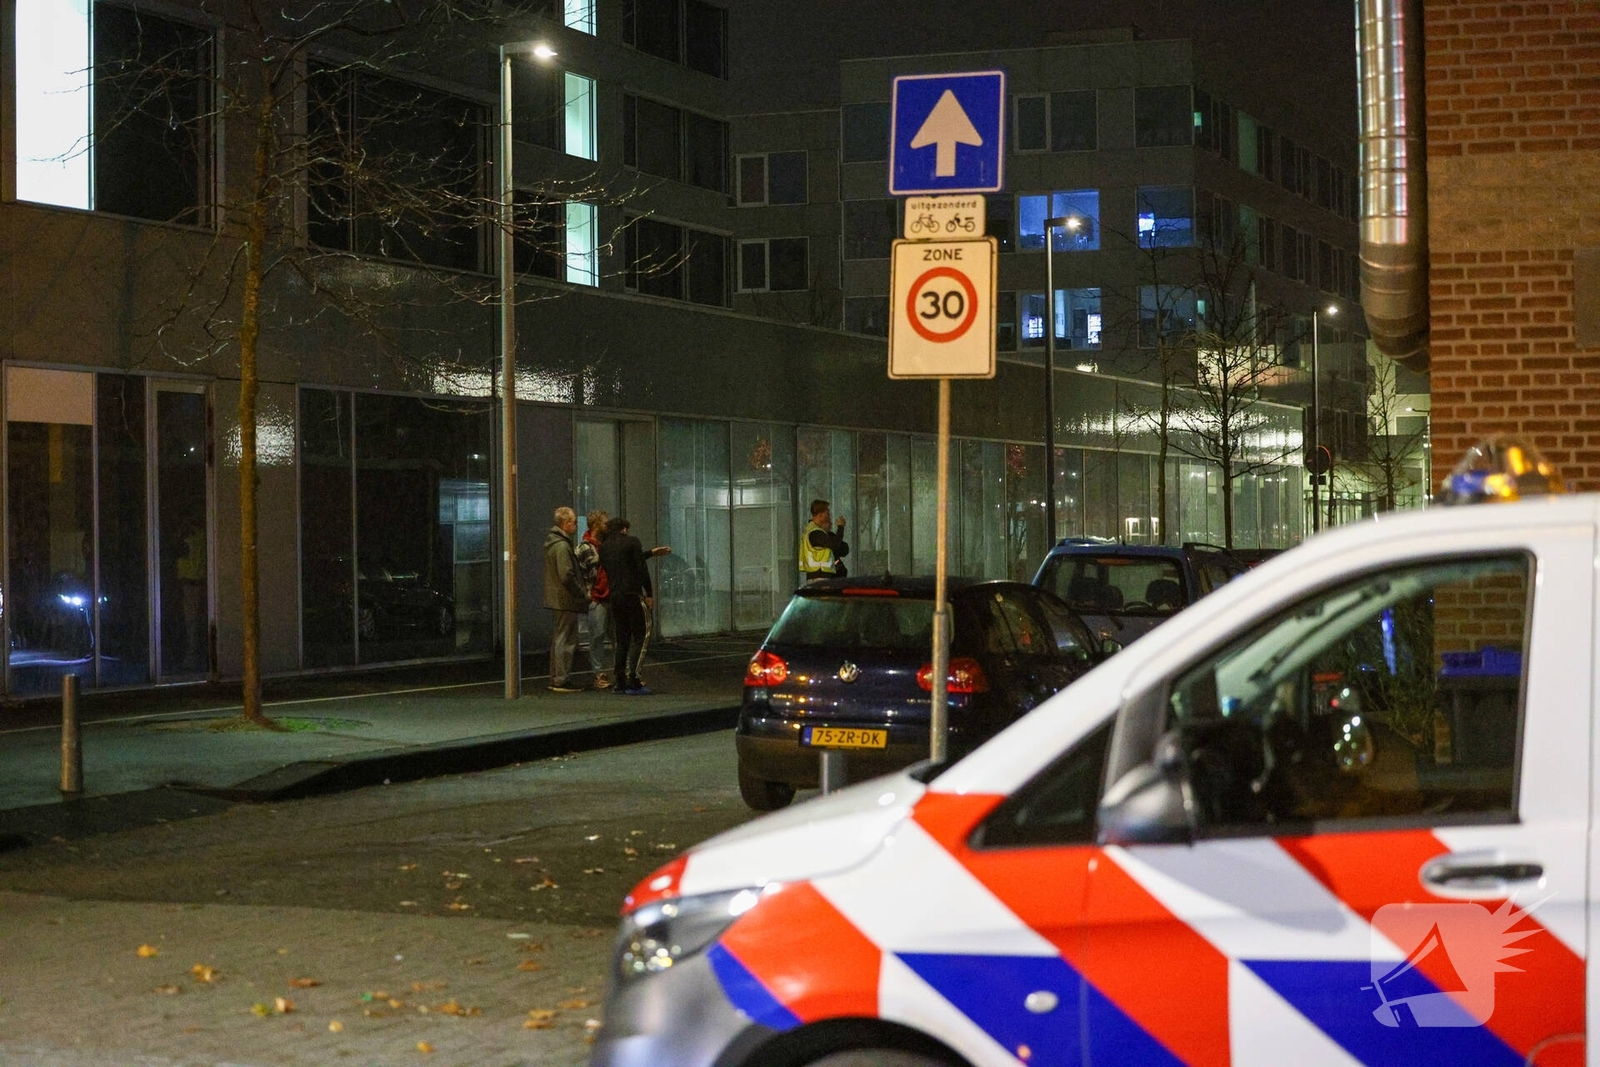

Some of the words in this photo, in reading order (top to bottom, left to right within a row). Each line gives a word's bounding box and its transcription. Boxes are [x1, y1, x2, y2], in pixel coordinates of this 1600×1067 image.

[911, 200, 977, 211] uitgezonderd
[923, 249, 963, 262] ZONE
[920, 291, 965, 320] 30
[816, 730, 880, 745] 75-ZR-DK
